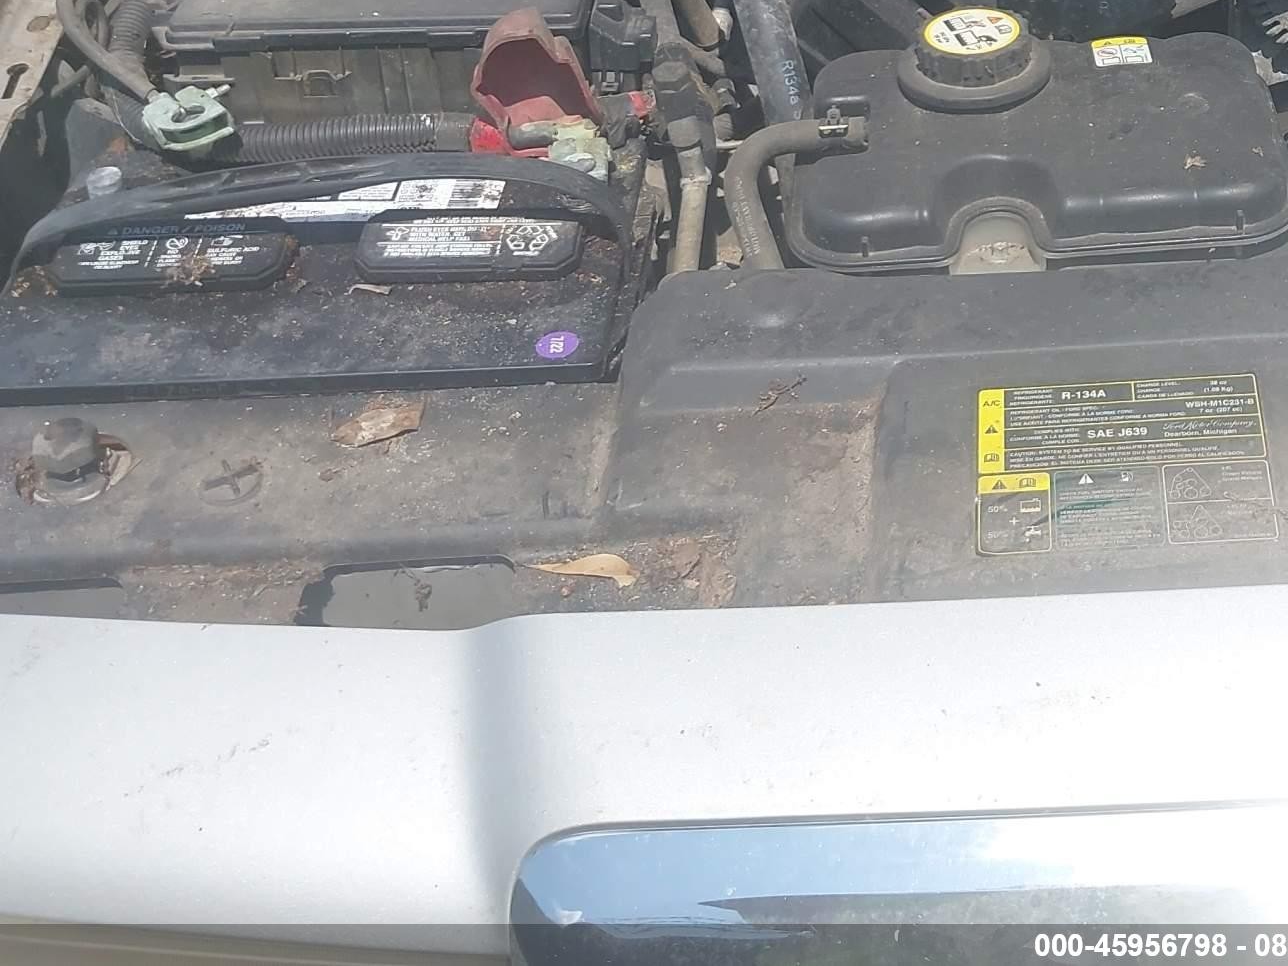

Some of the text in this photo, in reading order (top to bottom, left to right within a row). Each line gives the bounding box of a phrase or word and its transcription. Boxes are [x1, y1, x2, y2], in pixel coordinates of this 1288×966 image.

[121, 225, 180, 235] DANGER
[194, 223, 246, 233] POISON
[1061, 389, 1107, 400] R-134A
[1087, 428, 1114, 439] SAE
[1118, 427, 1148, 438] J639
